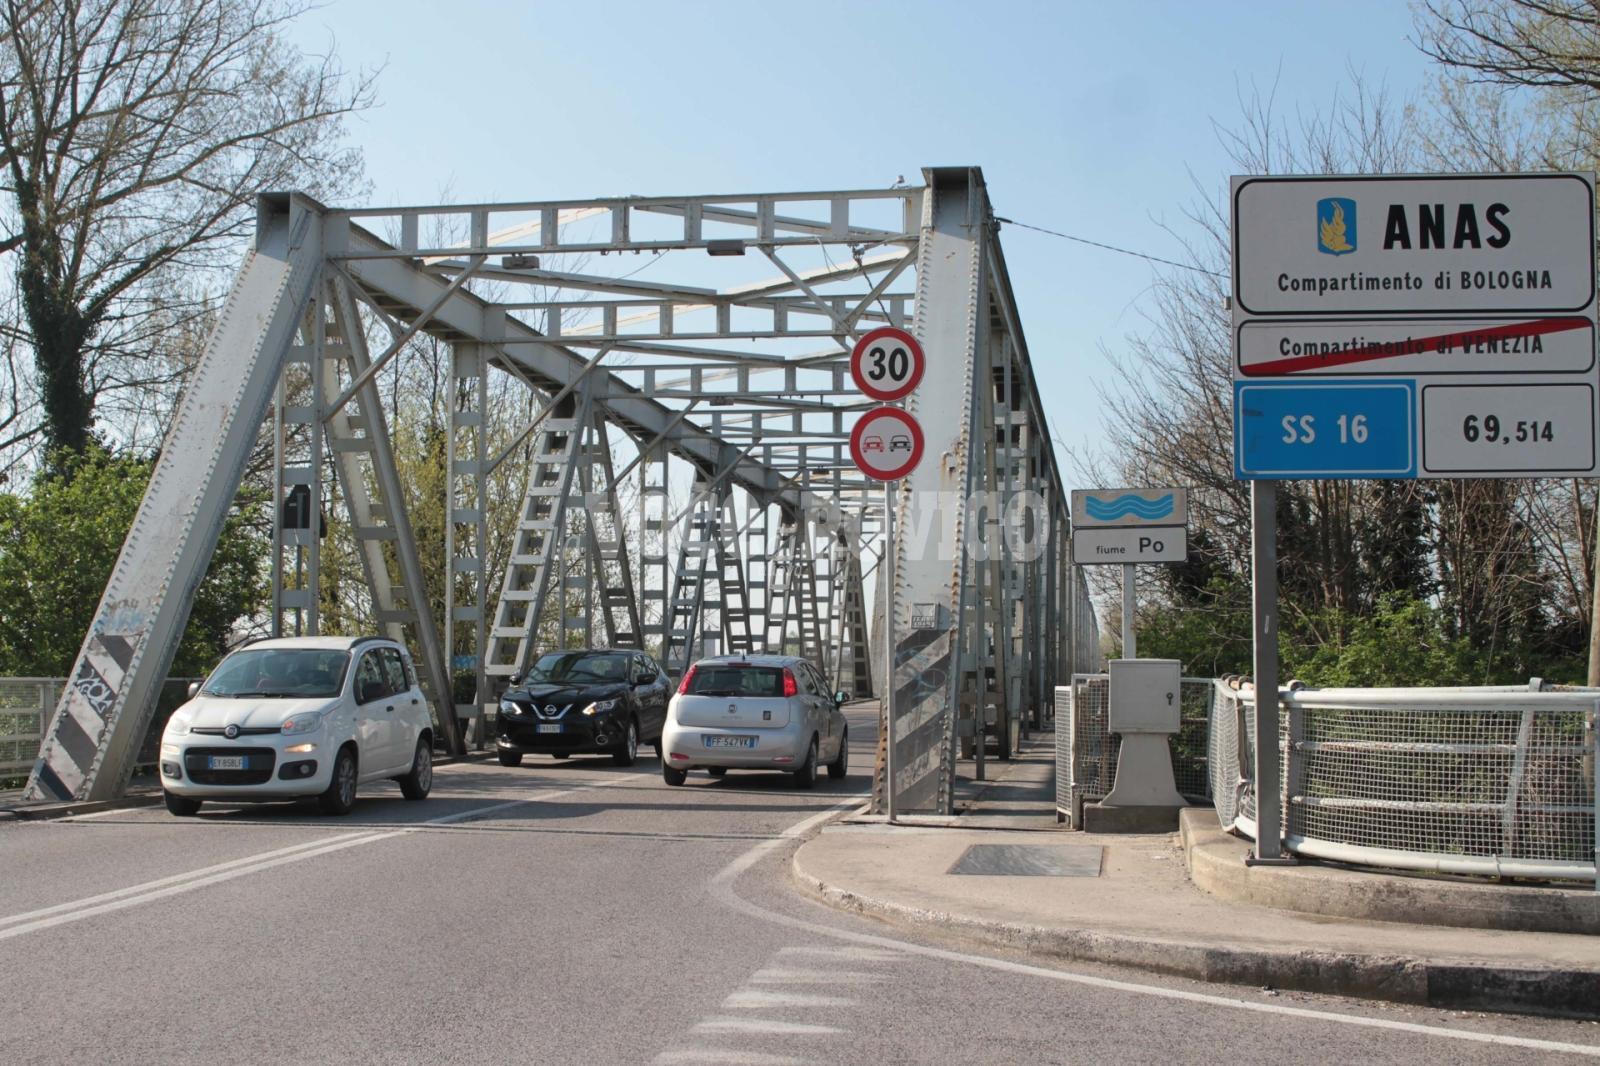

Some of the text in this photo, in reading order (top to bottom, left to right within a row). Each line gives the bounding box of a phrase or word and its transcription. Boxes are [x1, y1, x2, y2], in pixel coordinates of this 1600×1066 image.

[1383, 203, 1512, 250] ANAS
[1278, 270, 1552, 296] Compartimento di BOLOGNA
[1279, 334, 1544, 360] Compartimento di VENEZIA
[868, 347, 909, 382] 30
[1281, 415, 1369, 444] SS 16
[1463, 415, 1554, 445] 69,514
[1096, 537, 1164, 554] fiume Po
